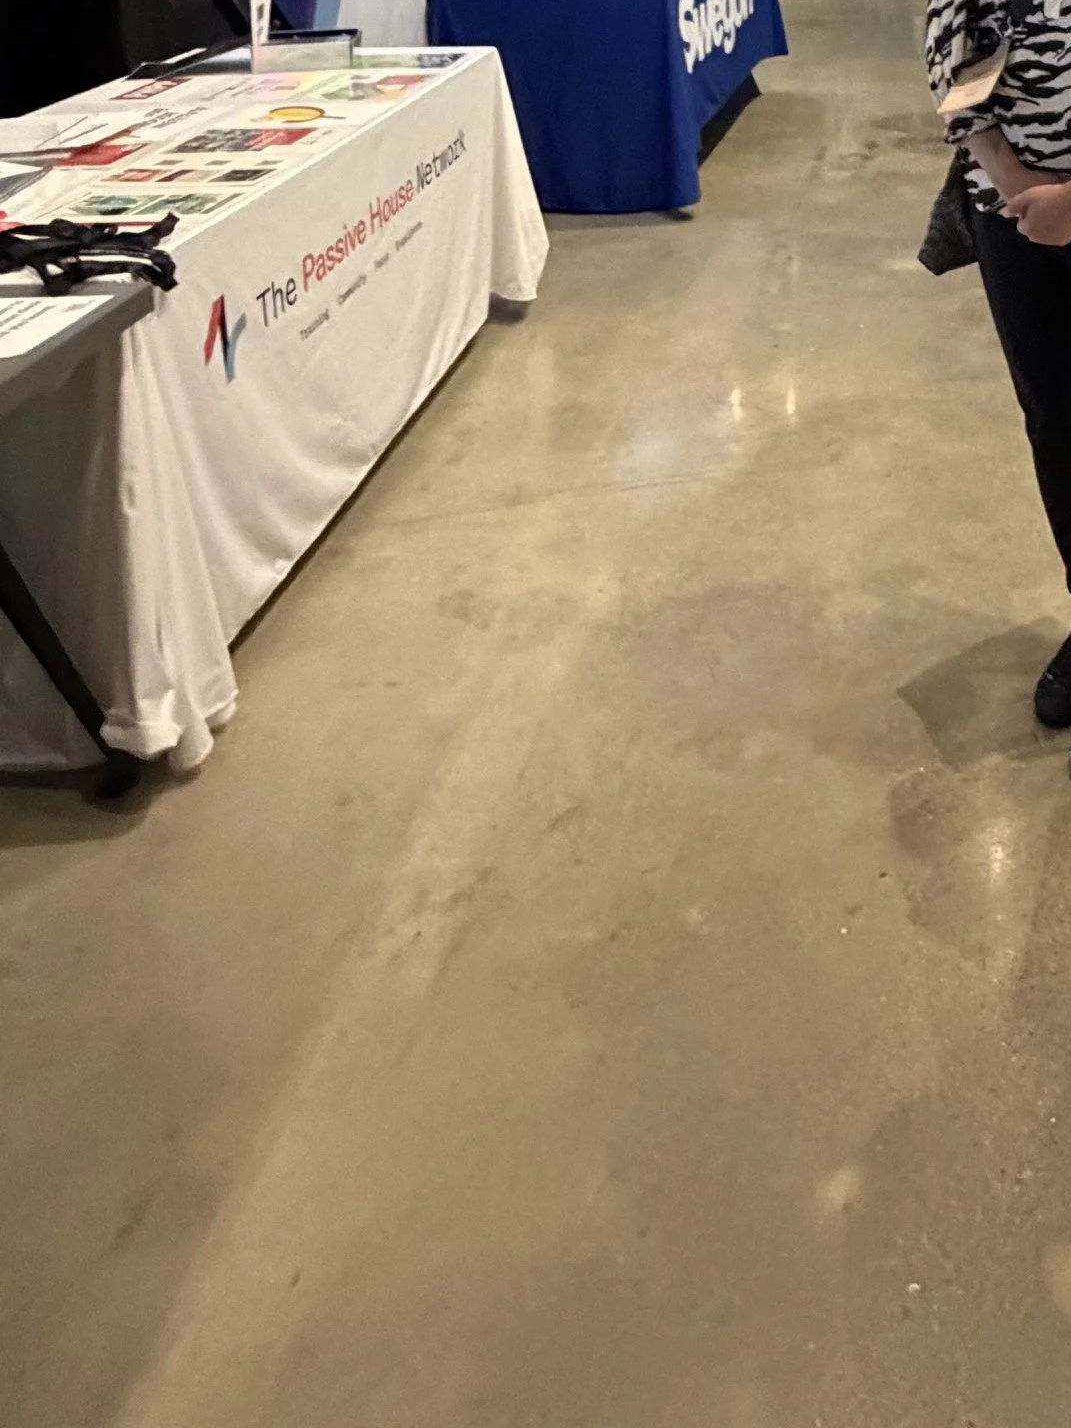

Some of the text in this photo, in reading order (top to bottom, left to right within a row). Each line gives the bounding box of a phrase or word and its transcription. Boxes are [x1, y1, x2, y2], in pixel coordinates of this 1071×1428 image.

[256, 278, 297, 327] The
[302, 220, 366, 292] Passive
[369, 180, 414, 234] House
[416, 128, 467, 193] Network
